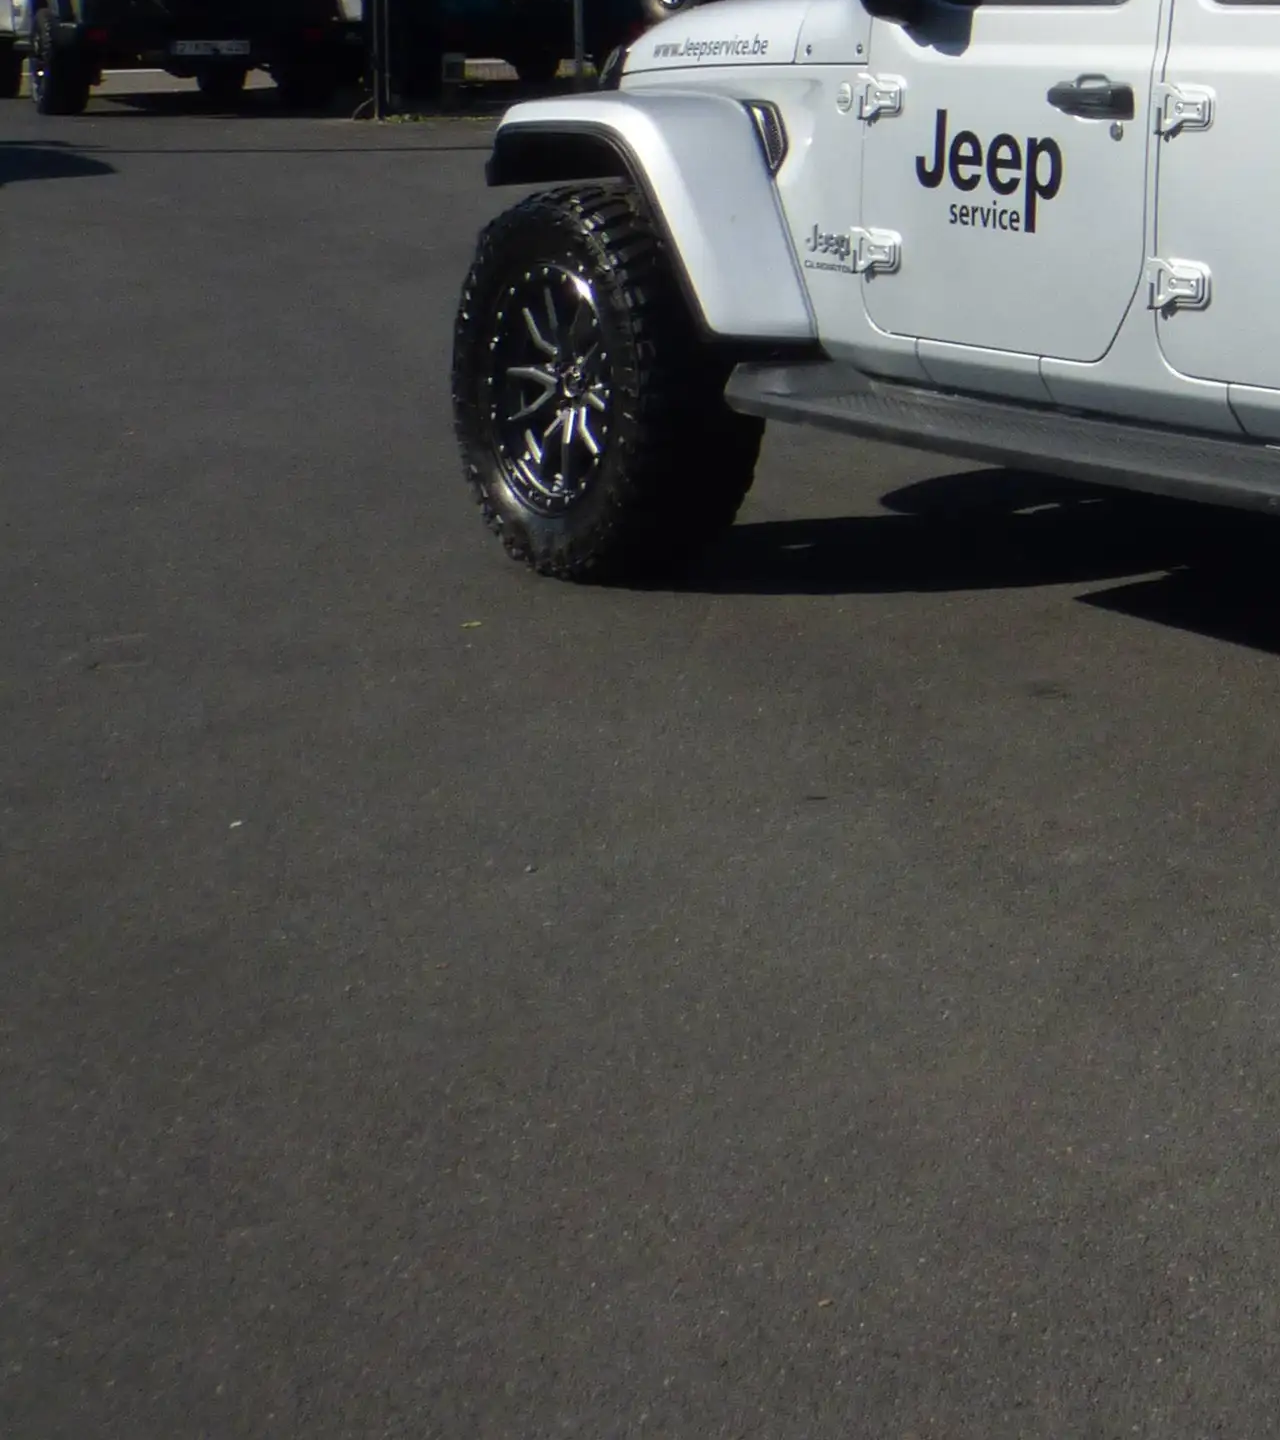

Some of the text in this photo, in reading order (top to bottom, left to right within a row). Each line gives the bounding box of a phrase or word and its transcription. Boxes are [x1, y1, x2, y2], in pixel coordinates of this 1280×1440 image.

[653, 33, 769, 62] www.Jeepservice.be
[915, 108, 1063, 233] Jeep
[949, 200, 1021, 232] service
[805, 223, 851, 262] Jeep
